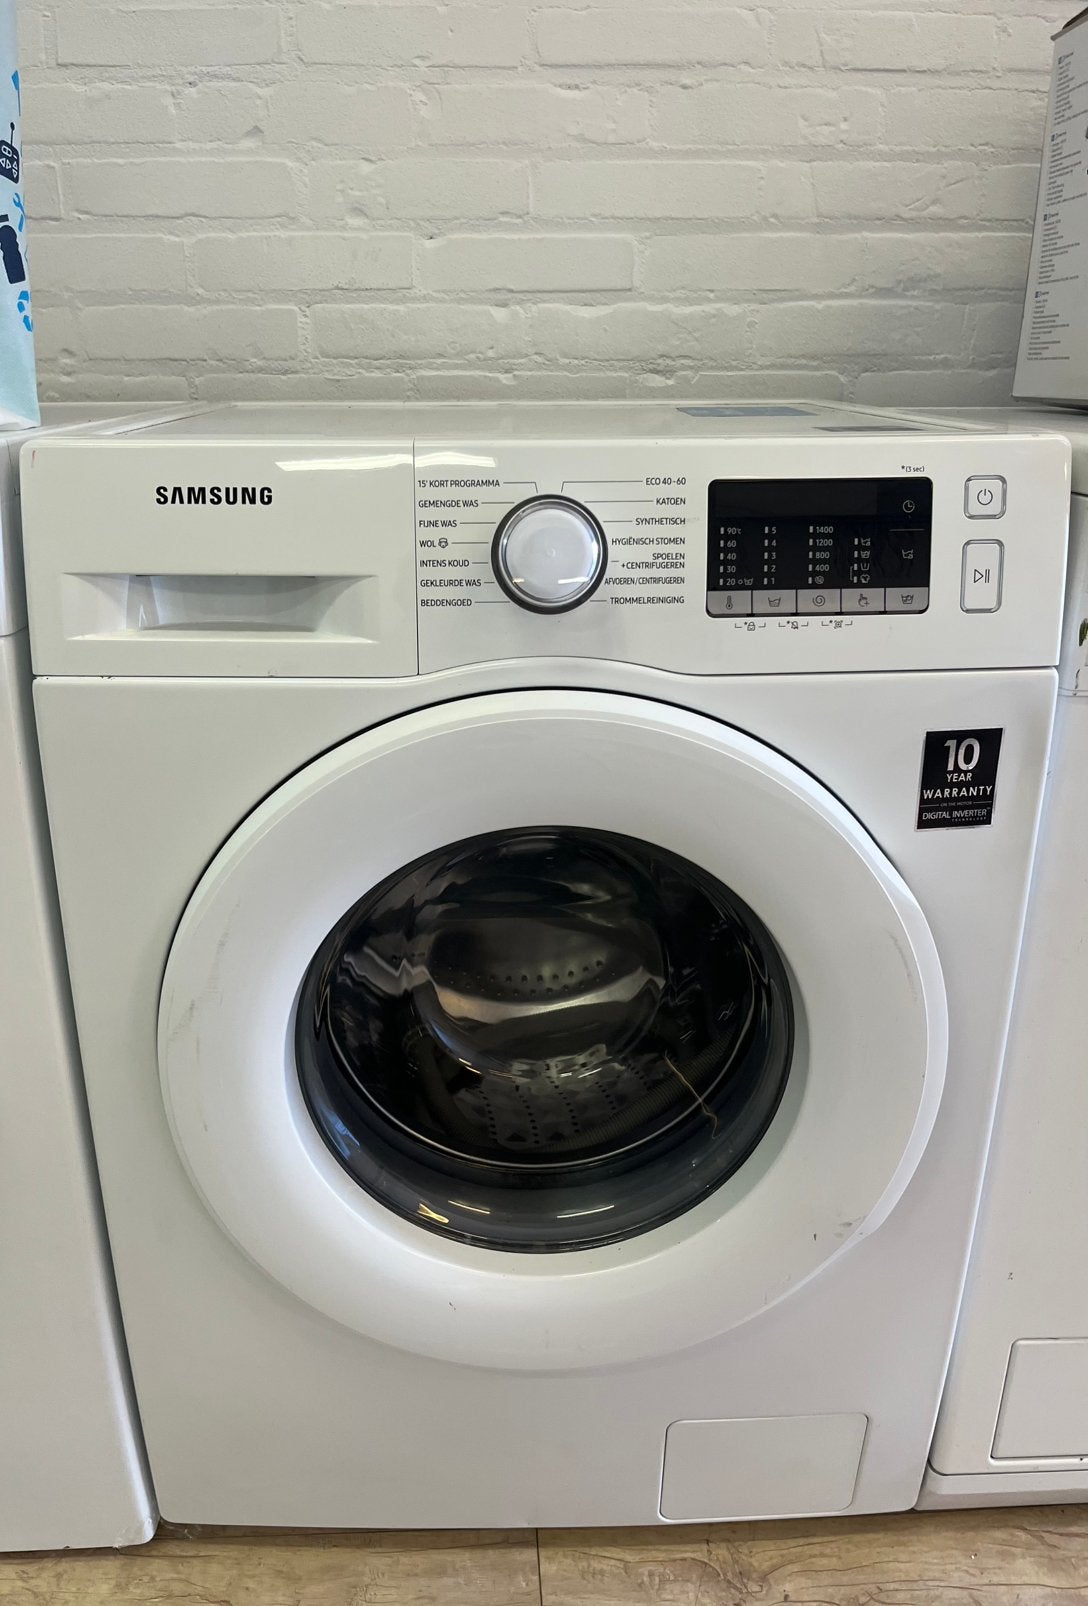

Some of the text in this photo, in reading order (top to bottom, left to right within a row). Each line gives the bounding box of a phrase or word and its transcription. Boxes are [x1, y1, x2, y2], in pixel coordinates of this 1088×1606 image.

[418, 480, 500, 488] 15' KORT PROGRAMMA
[645, 477, 661, 486] ECO
[156, 486, 273, 505] SAMSUNG
[418, 500, 479, 508] GEMENGDE WAS
[656, 497, 686, 506] KATOEN
[418, 520, 439, 528] FIJNE
[635, 517, 686, 526] SYNTHETISCH
[771, 526, 777, 534] 5
[815, 525, 834, 534] 1400
[419, 540, 437, 548] WOL
[611, 536, 686, 546] HYGIËNISCH STOMEN
[726, 540, 737, 548] 60
[771, 539, 777, 547] 4
[815, 538, 833, 546] 1200
[652, 553, 685, 561] SPOELEN
[726, 553, 737, 561] 40
[771, 552, 777, 560] 3
[815, 551, 830, 559] 800
[420, 560, 470, 568] INTENS KOUD
[815, 564, 830, 572] 400
[726, 565, 737, 573] 30
[770, 564, 777, 573] 2
[420, 579, 482, 587] GEKLEURDE WAS
[726, 578, 736, 586] 20
[420, 599, 472, 608] BEDDENGOED
[610, 596, 685, 606] TROMMELREINIGING
[943, 737, 981, 771] 10
[946, 772, 973, 783] YEAR
[923, 785, 993, 800] WARRANTY
[922, 811, 951, 820] DIGITAL
[952, 809, 987, 817] INVERTER
